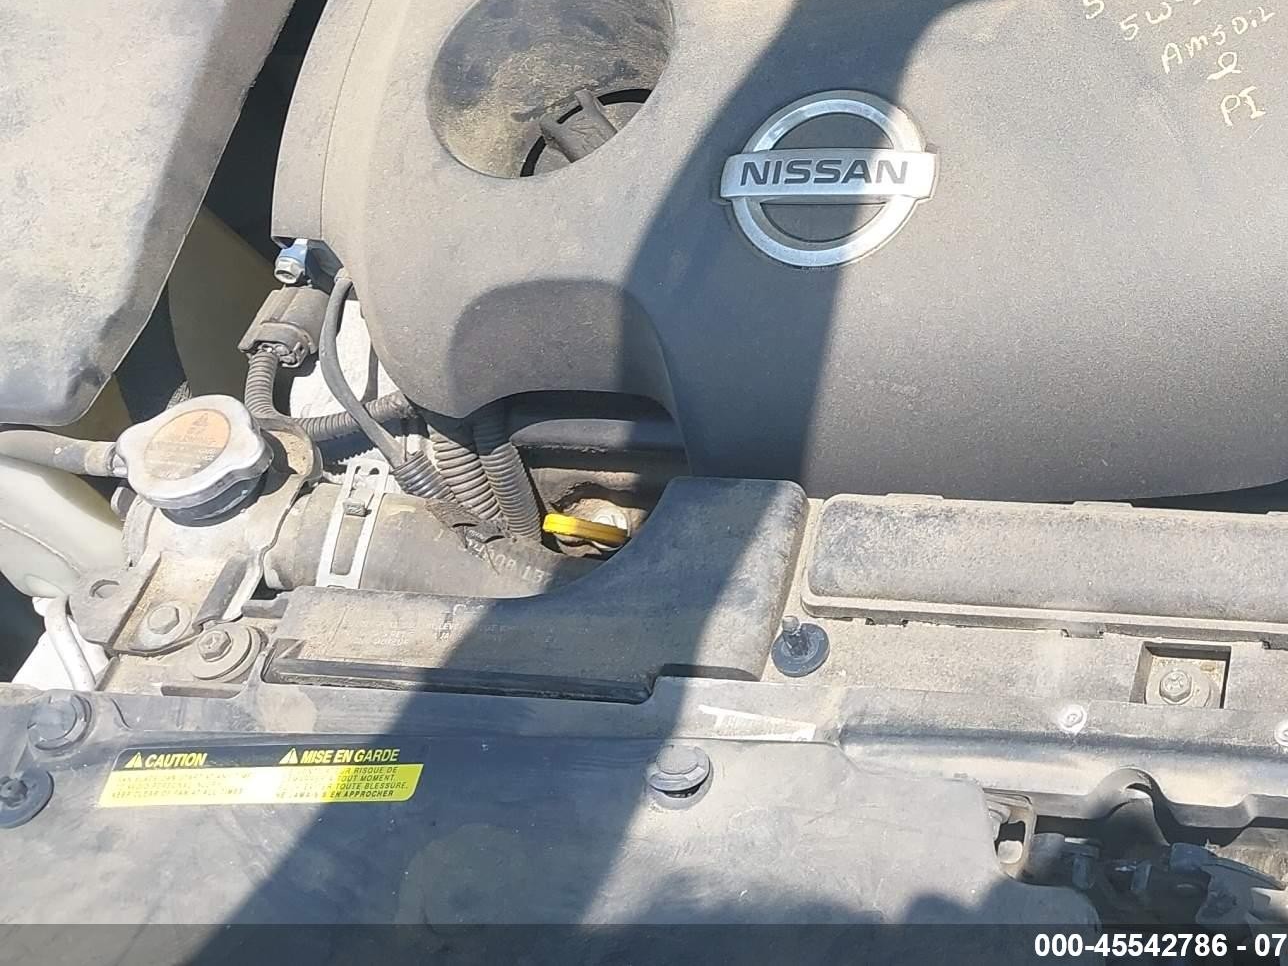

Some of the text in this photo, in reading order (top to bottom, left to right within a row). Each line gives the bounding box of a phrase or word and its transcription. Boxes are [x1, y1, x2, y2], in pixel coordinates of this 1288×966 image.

[739, 158, 910, 186] NISSAN
[144, 752, 208, 768] CAUTION
[300, 748, 400, 764] MISE EN GARDE
[386, 766, 399, 774] DE
[336, 782, 363, 790] TOUTE
